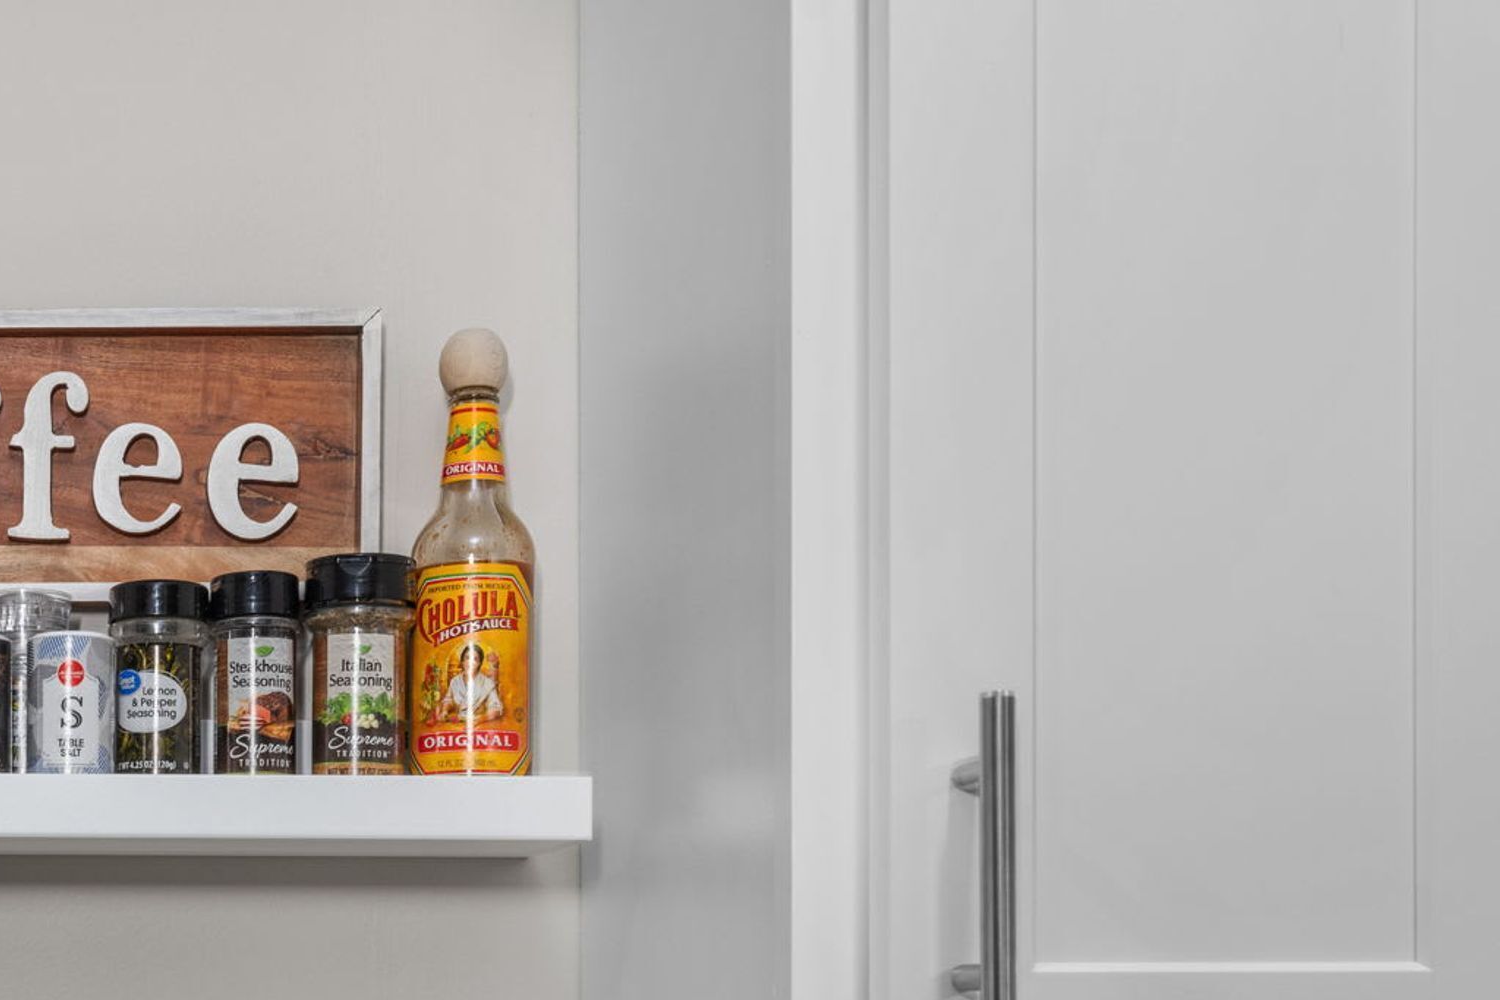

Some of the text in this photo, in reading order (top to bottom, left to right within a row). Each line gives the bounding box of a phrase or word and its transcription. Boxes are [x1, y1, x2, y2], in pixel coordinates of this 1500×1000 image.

[446, 463, 500, 475] ORIGINAL
[419, 590, 519, 644] CHOLULA
[439, 618, 512, 643] HOT SAUCE
[60, 696, 83, 728] S
[328, 726, 394, 750] Supreme
[423, 734, 512, 749] ORIGNAL
